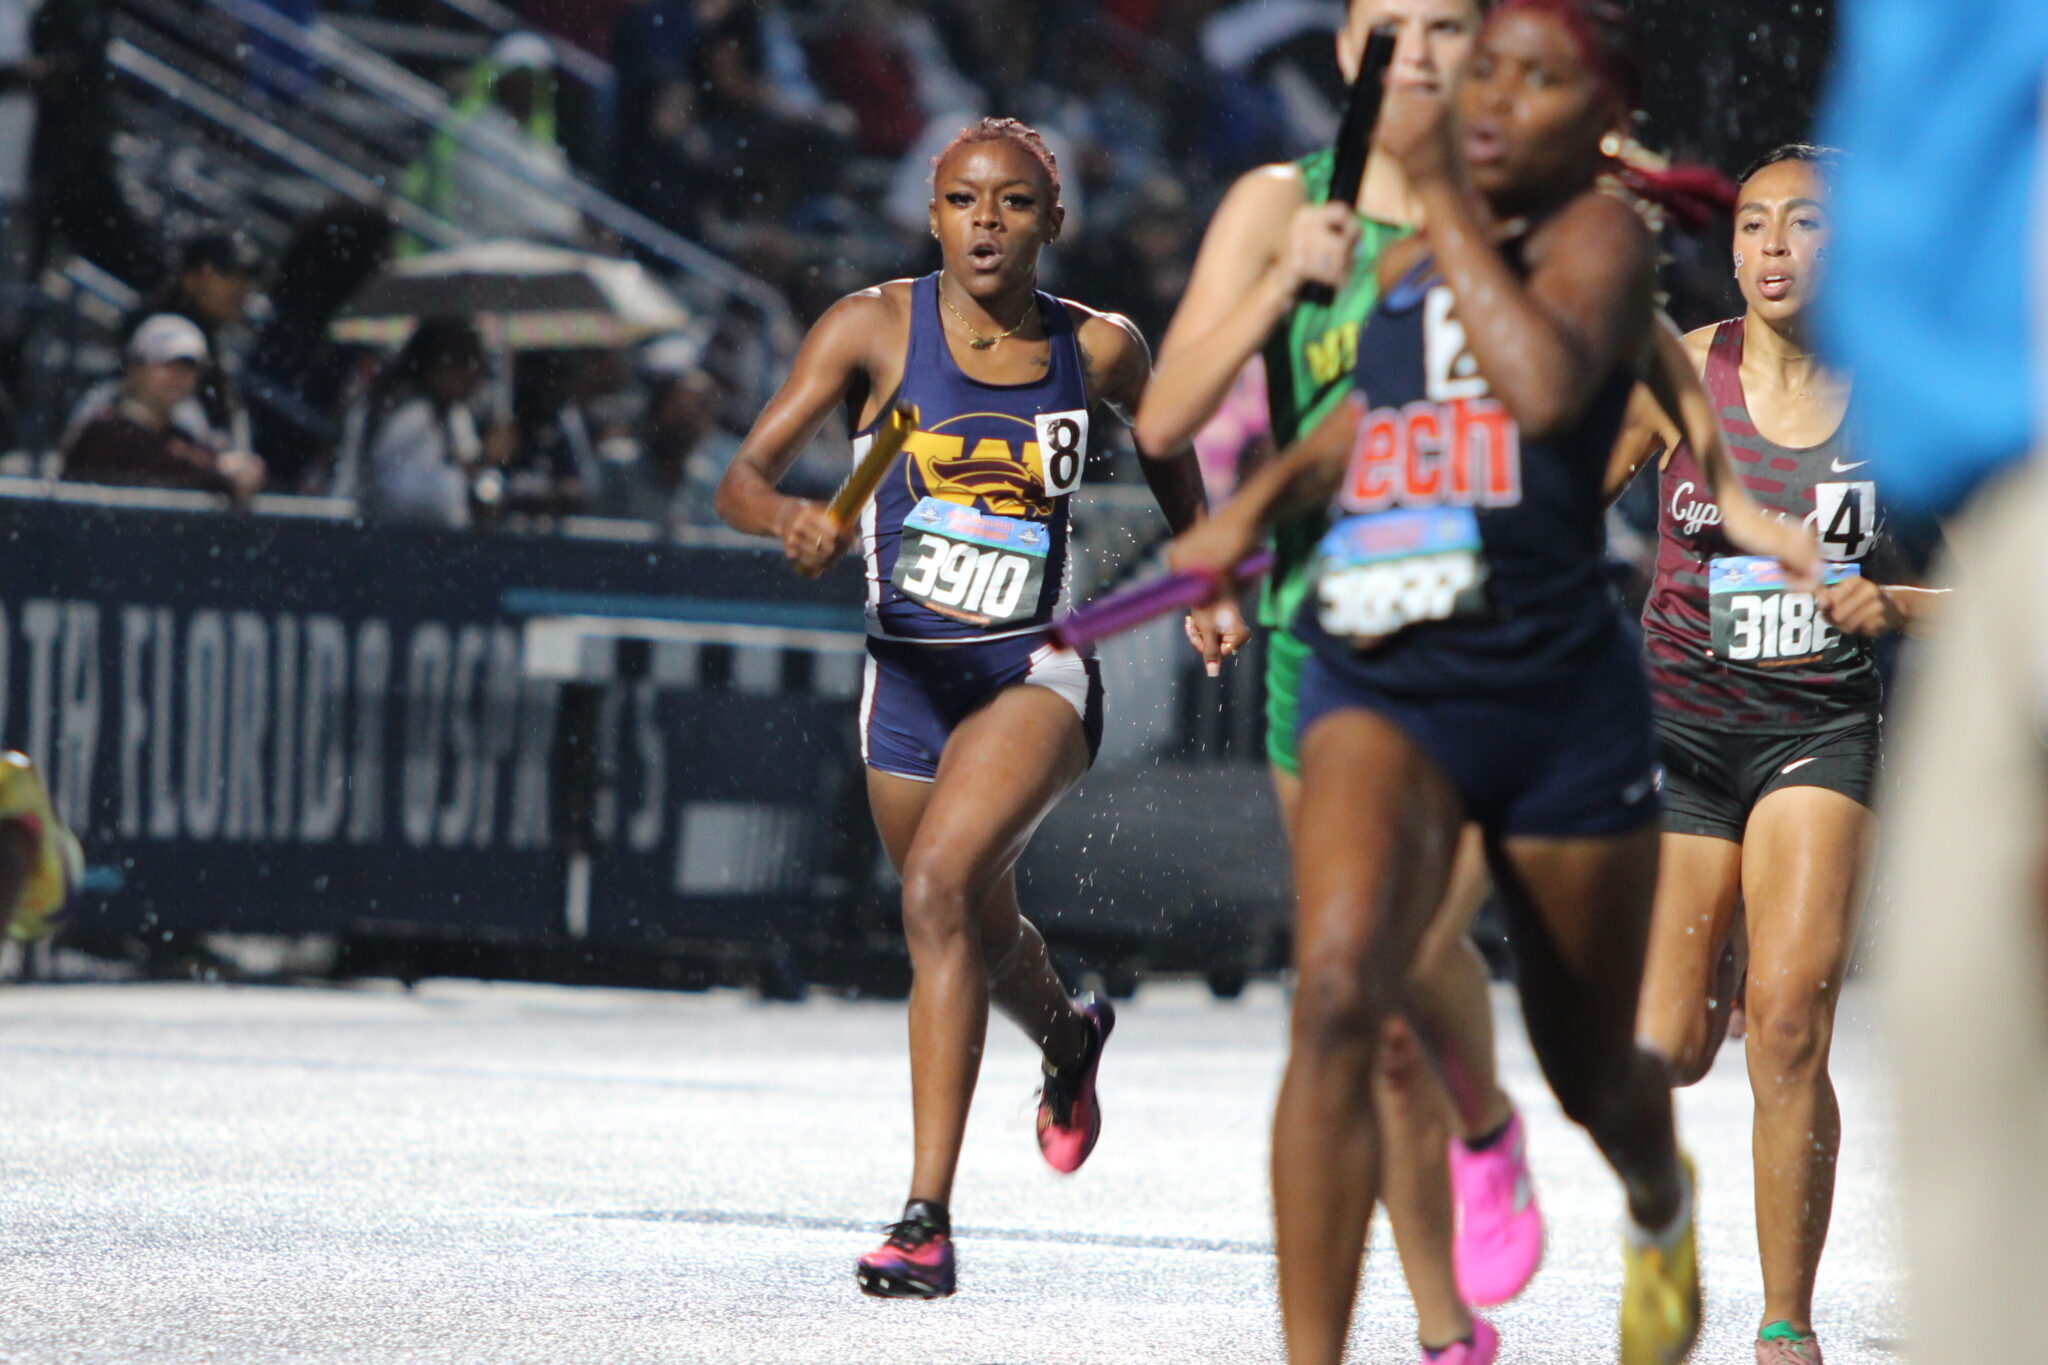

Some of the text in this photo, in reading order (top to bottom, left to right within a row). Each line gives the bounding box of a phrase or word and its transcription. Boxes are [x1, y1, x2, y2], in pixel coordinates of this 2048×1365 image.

[1048, 418, 1079, 489] 8
[1340, 388, 1522, 512] ech
[1824, 488, 1865, 556] 4
[902, 534, 1030, 618] 3910
[119, 604, 391, 844] FLORIDA
